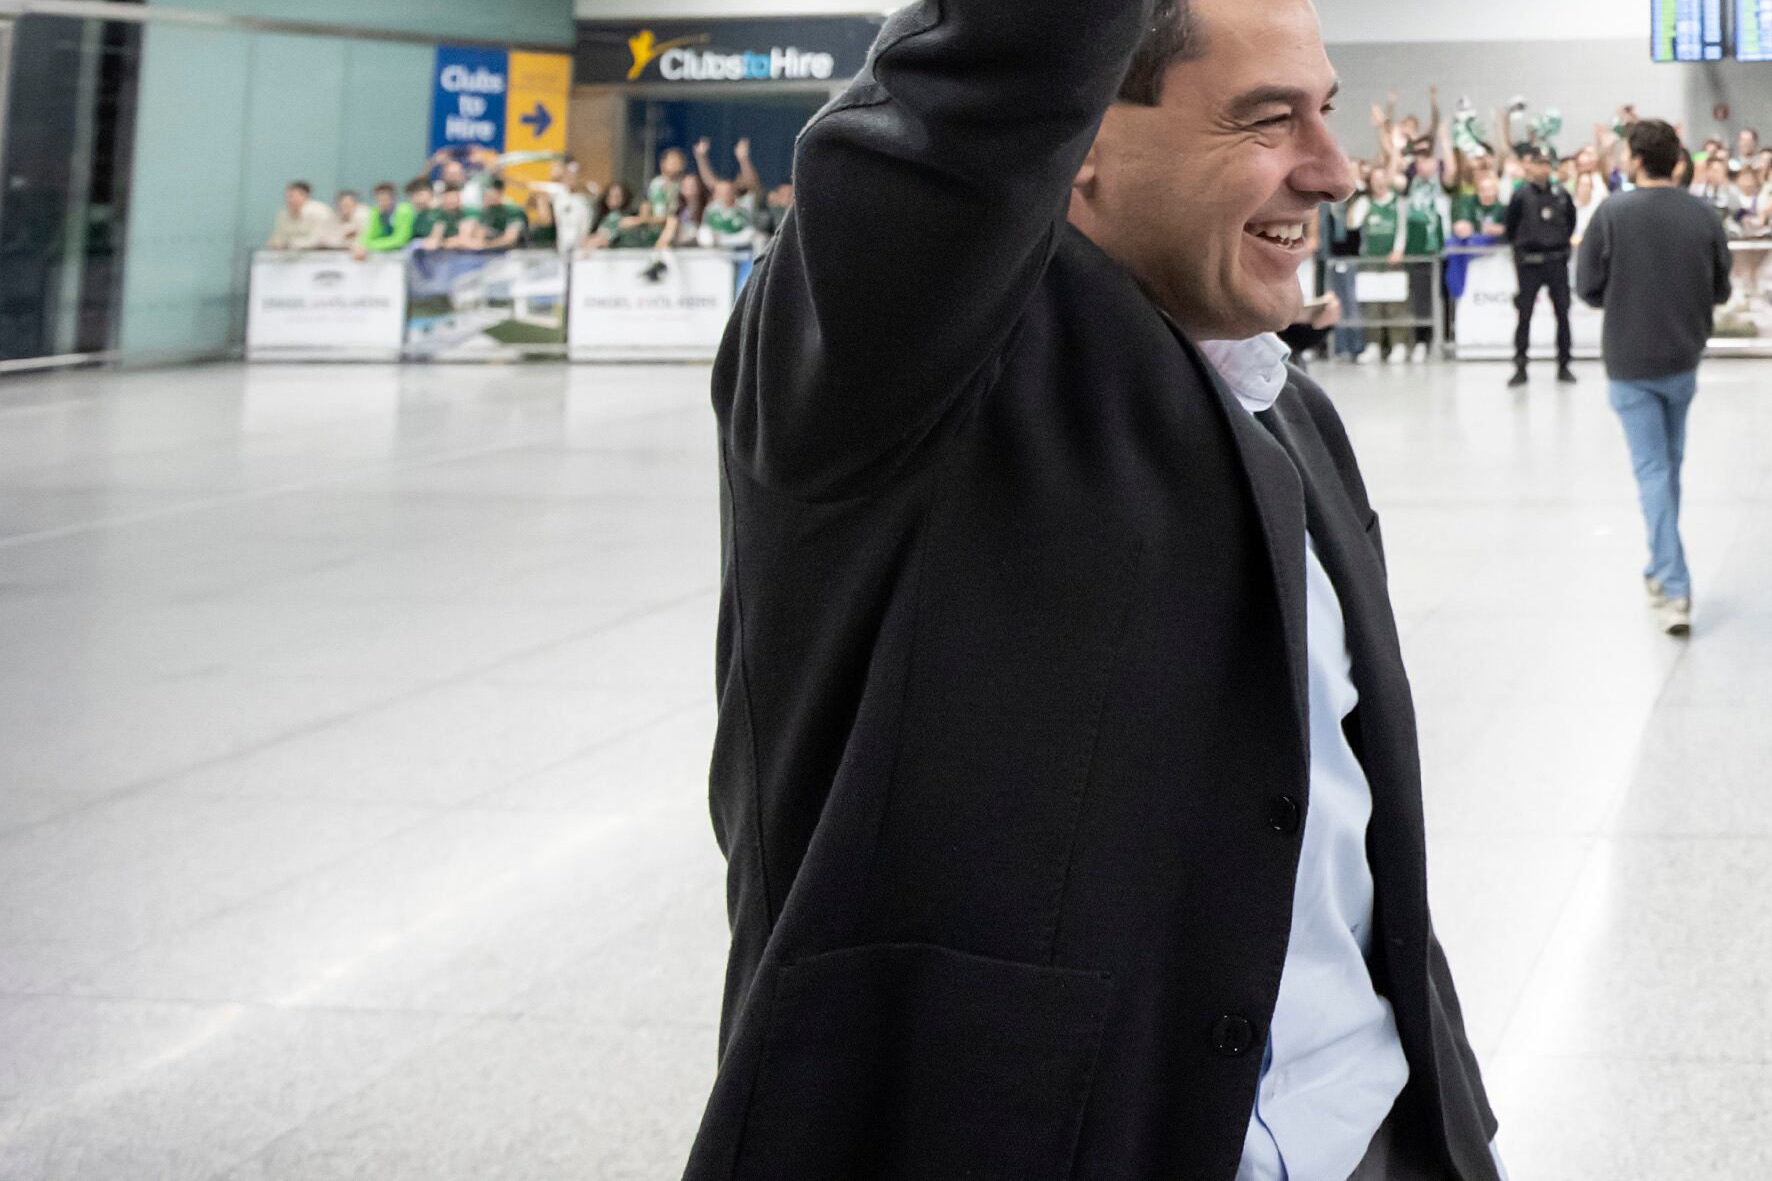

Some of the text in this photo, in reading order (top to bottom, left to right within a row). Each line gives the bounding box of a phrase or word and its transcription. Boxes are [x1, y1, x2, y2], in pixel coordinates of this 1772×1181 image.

[659, 45, 835, 81] ClubstoHire
[440, 64, 505, 94] Clubs
[458, 94, 488, 118] to
[445, 114, 496, 141] Hire
